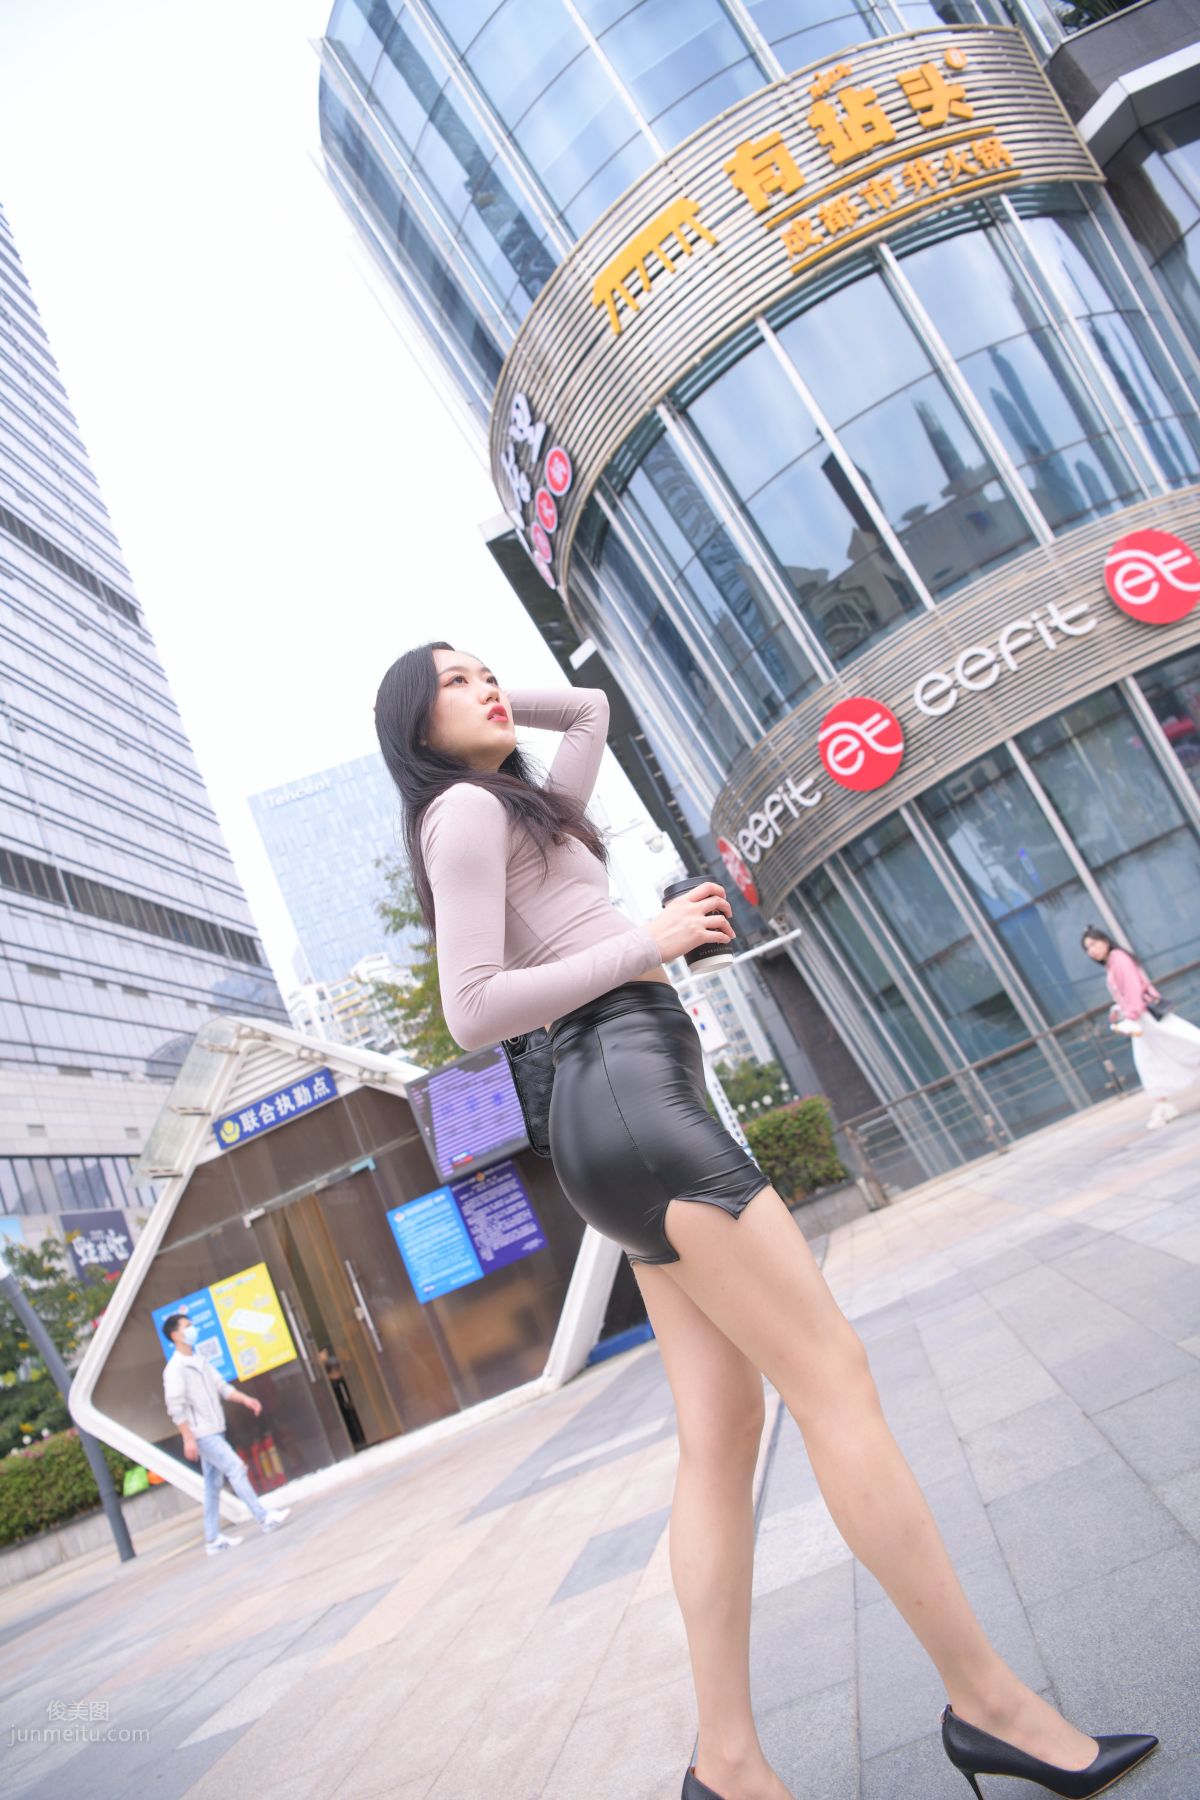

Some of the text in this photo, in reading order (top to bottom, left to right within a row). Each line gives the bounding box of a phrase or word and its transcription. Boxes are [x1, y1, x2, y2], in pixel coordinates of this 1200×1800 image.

[780, 137, 1013, 259] 成都市井火锅
[913, 600, 1098, 717] eefit
[738, 776, 823, 864] eefit
[241, 1075, 333, 1134] 联合执勤点
